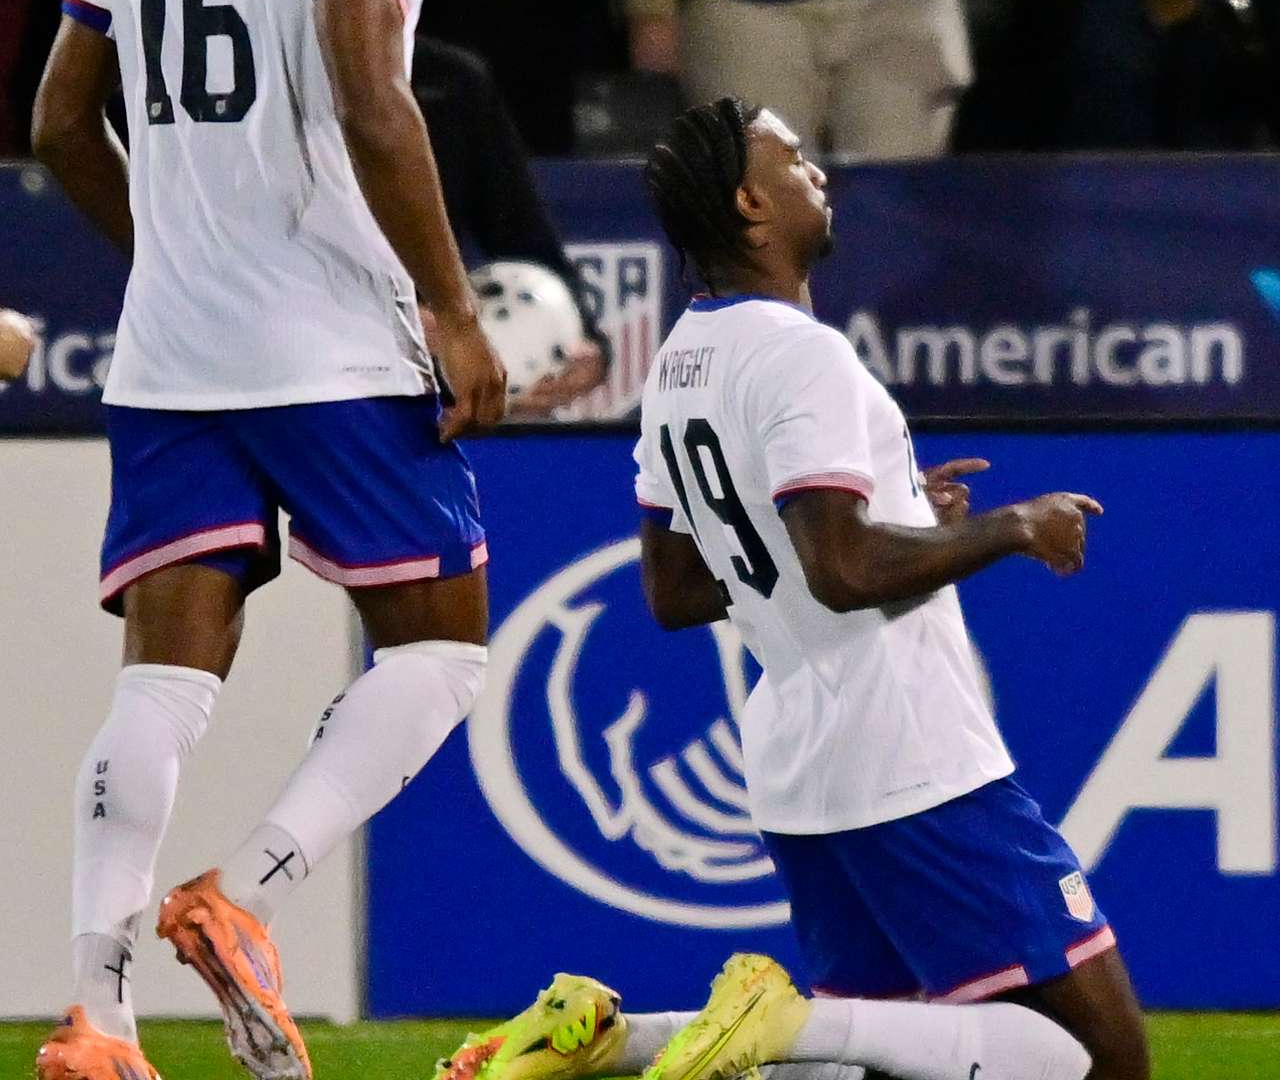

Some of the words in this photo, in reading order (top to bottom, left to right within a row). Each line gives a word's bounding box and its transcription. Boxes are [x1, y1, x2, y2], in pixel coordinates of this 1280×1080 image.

[846, 307, 1243, 386] American
[660, 418, 779, 614] 19
[92, 759, 109, 820] USA
